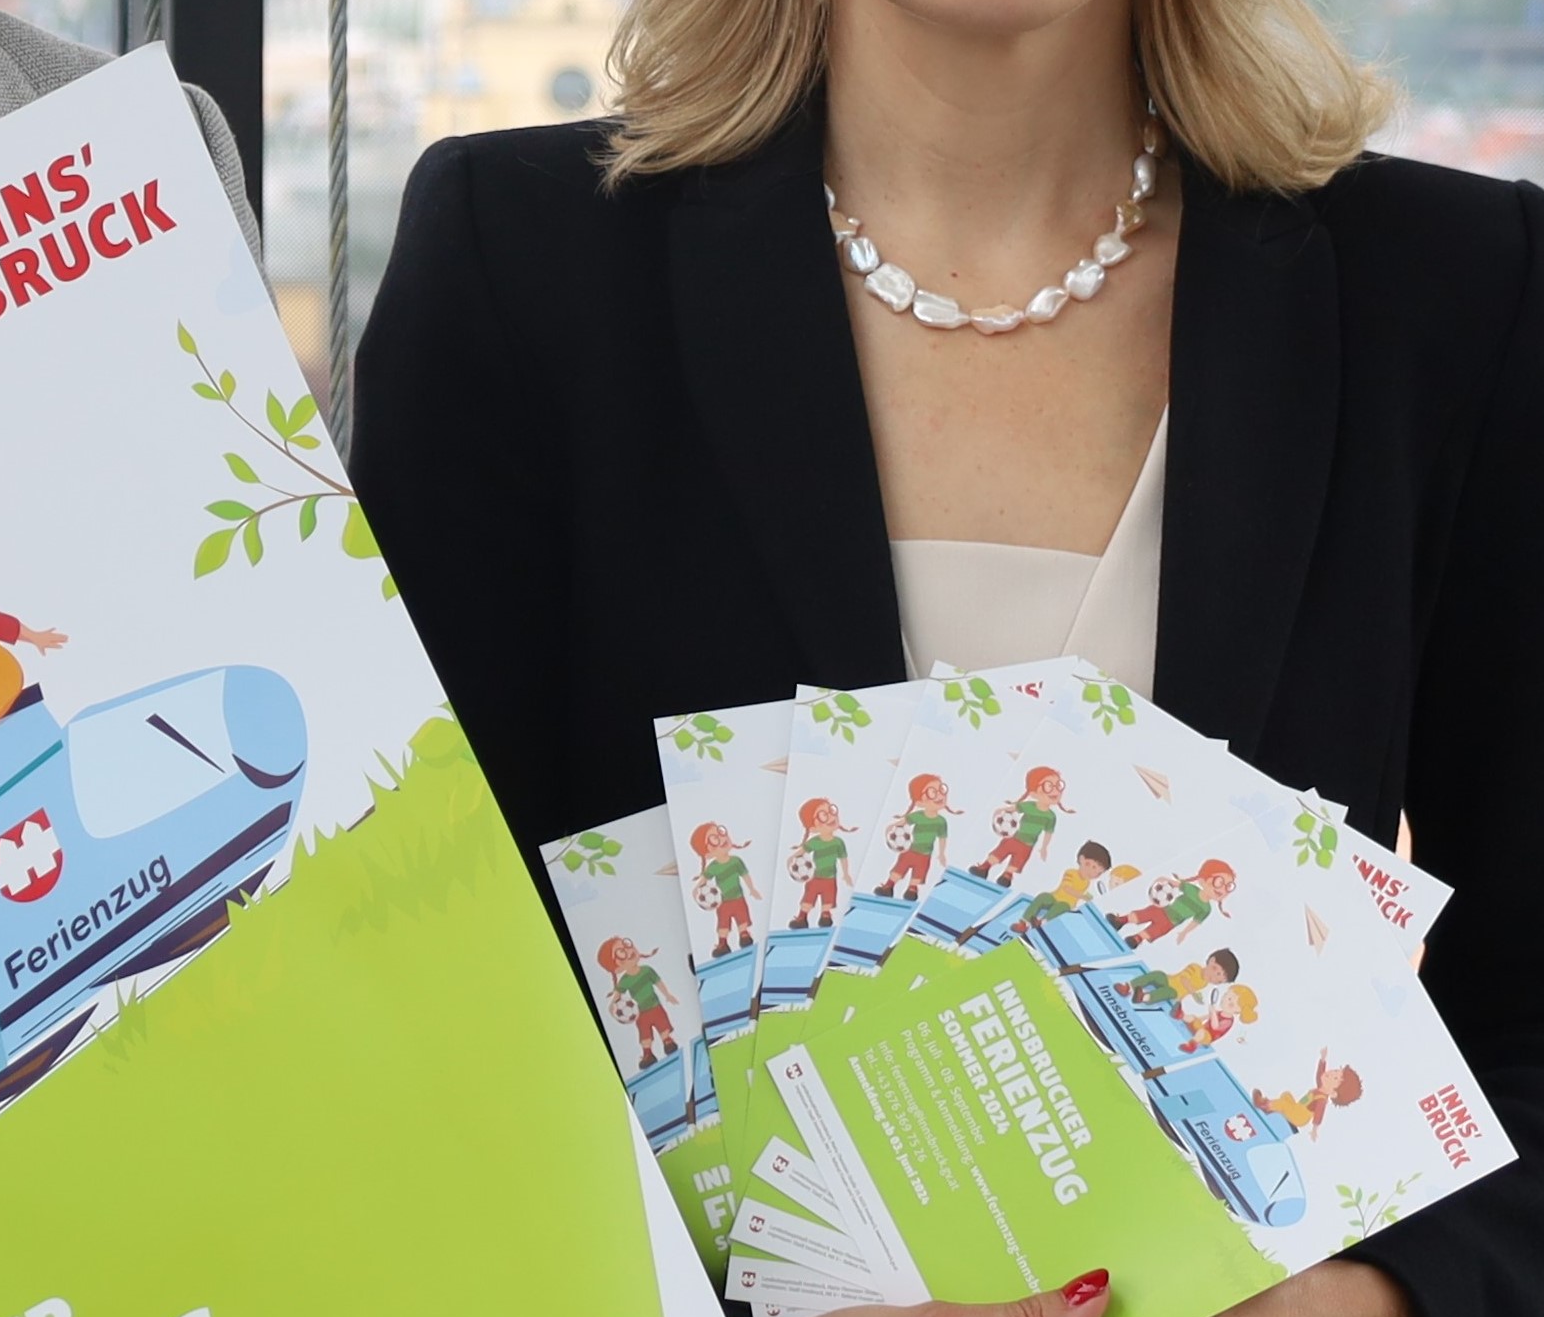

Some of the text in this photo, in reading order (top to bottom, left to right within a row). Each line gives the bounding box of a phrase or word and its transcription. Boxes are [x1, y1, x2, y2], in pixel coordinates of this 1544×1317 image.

[939, 1010, 1010, 1134] SOMMER 2024
[994, 981, 1091, 1148] INNSBRUCKER
[1096, 983, 1156, 1060] Innsbrucker
[845, 1054, 931, 1206] Anmeldung ab 03. Juni 2024
[882, 1089, 902, 1112] 676
[894, 1111, 912, 1133] 369
[904, 1131, 920, 1148] 75
[912, 1147, 928, 1164] 26
[922, 1039, 943, 1062] Juli
[946, 1085, 987, 1148] September
[960, 994, 1087, 1204] FERIENZUG
[1419, 1094, 1470, 1169] BRUCK
[1438, 1084, 1482, 1144] INNS'
[897, 1028, 1044, 1297] Programm & Anmeldung: www.ferienzug-innsbr
[1194, 1119, 1241, 1182] Ferienzug
